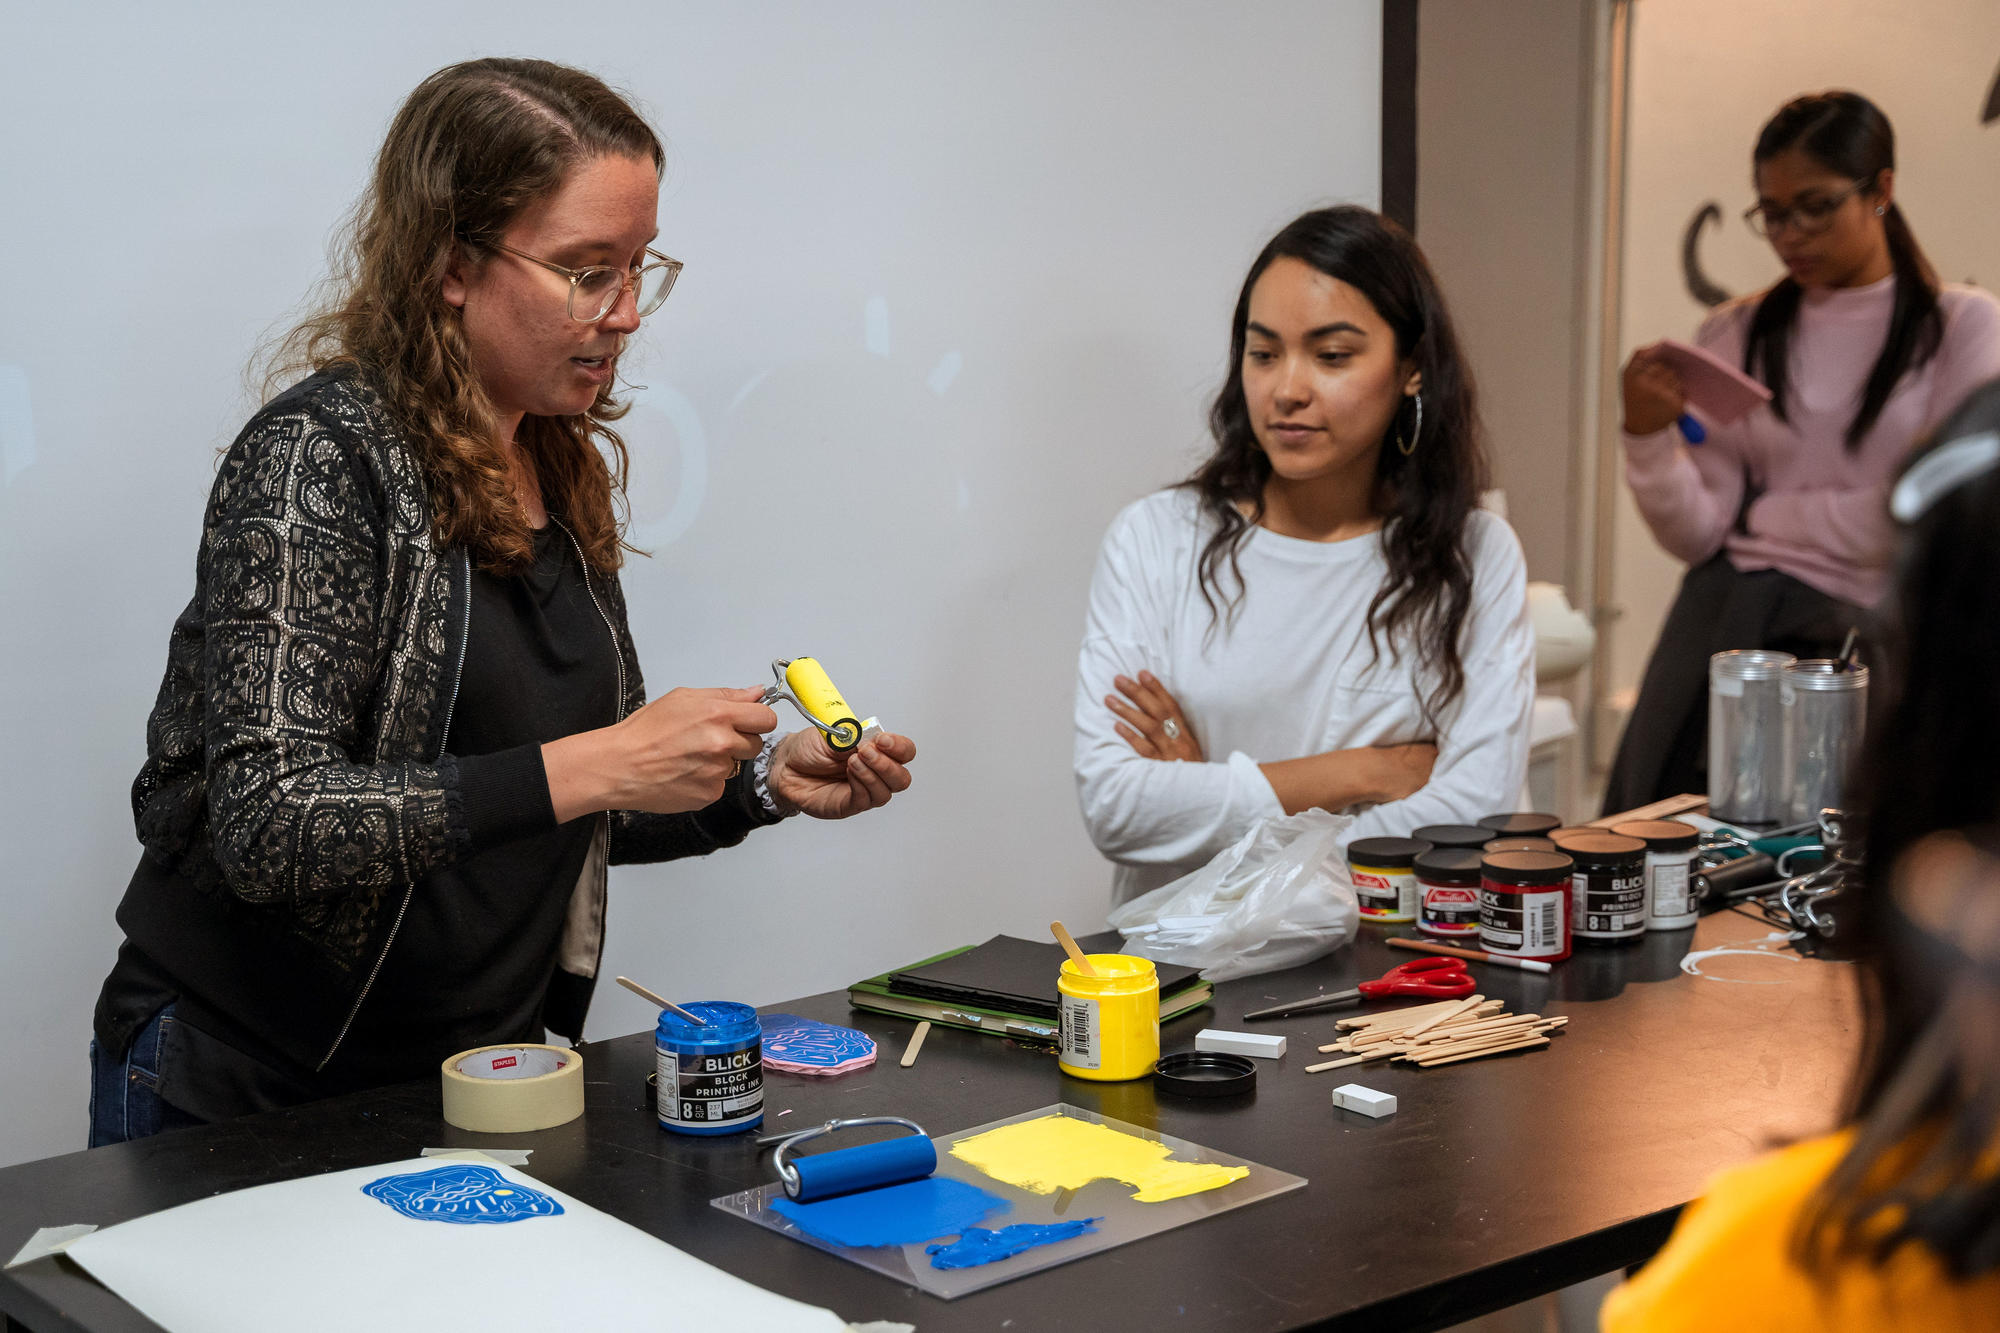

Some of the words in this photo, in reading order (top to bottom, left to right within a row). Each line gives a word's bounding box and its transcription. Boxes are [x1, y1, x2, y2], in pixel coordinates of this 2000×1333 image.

[1588, 915, 1599, 930] 8
[494, 1059, 515, 1067] STAPLES
[706, 1053, 751, 1071] BLICK
[715, 1071, 748, 1085] BLOCK
[696, 1084, 746, 1097] PRINTING
[747, 1078, 760, 1089] INK
[682, 1102, 693, 1119] 8
